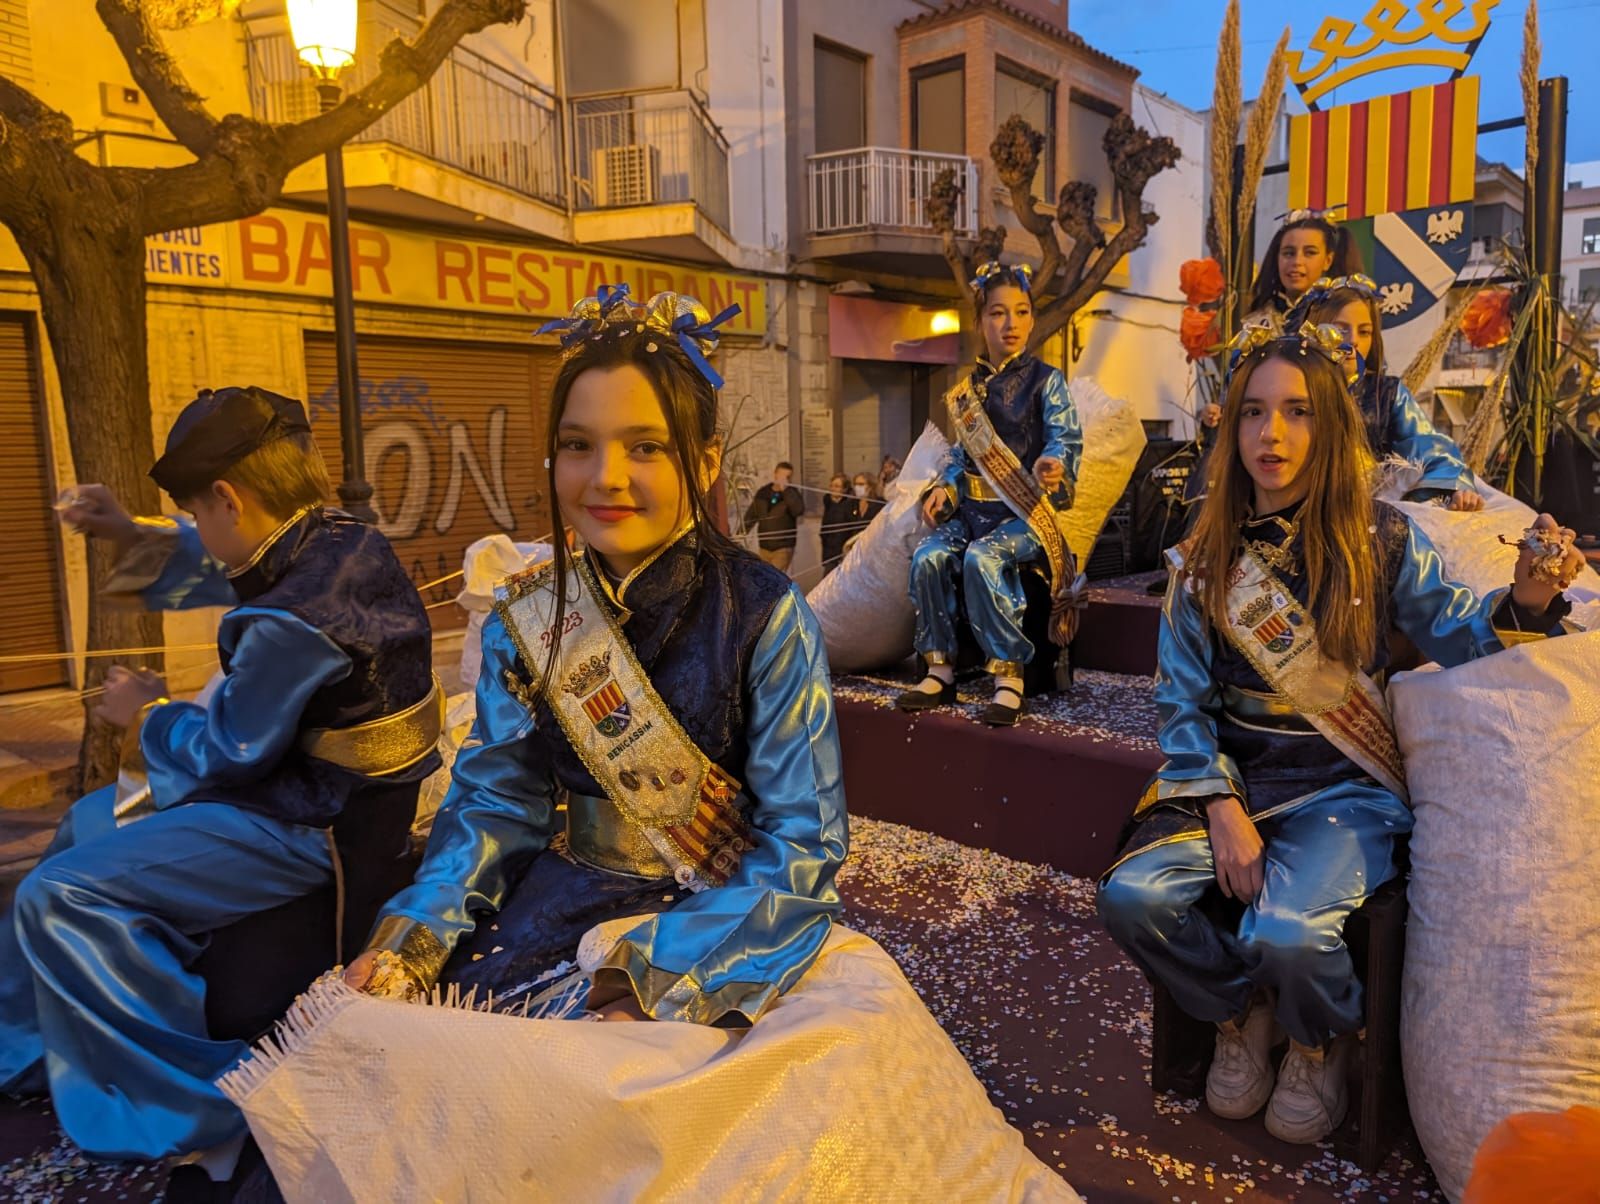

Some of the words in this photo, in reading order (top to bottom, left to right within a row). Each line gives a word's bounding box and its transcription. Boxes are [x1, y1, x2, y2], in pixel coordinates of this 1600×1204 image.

[145, 248, 220, 278] IENTES
[239, 214, 392, 295] BAR
[606, 720, 654, 761] BENICASSIM
